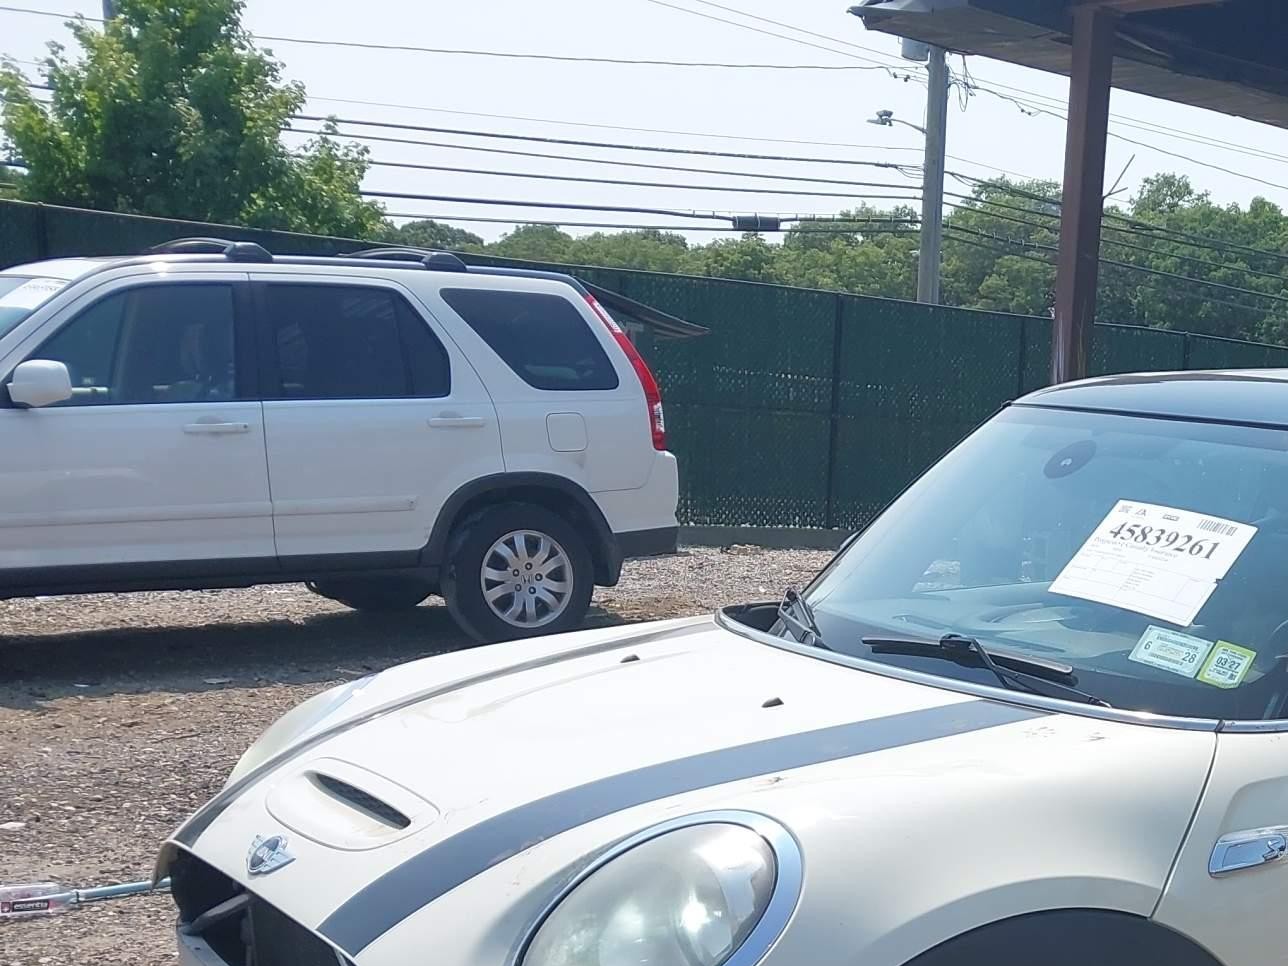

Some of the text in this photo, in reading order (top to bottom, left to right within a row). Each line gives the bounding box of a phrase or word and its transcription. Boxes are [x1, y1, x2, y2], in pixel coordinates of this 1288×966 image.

[1109, 521, 1221, 560] 45839261
[1143, 640, 1153, 651] 6
[1181, 651, 1198, 664] 28
